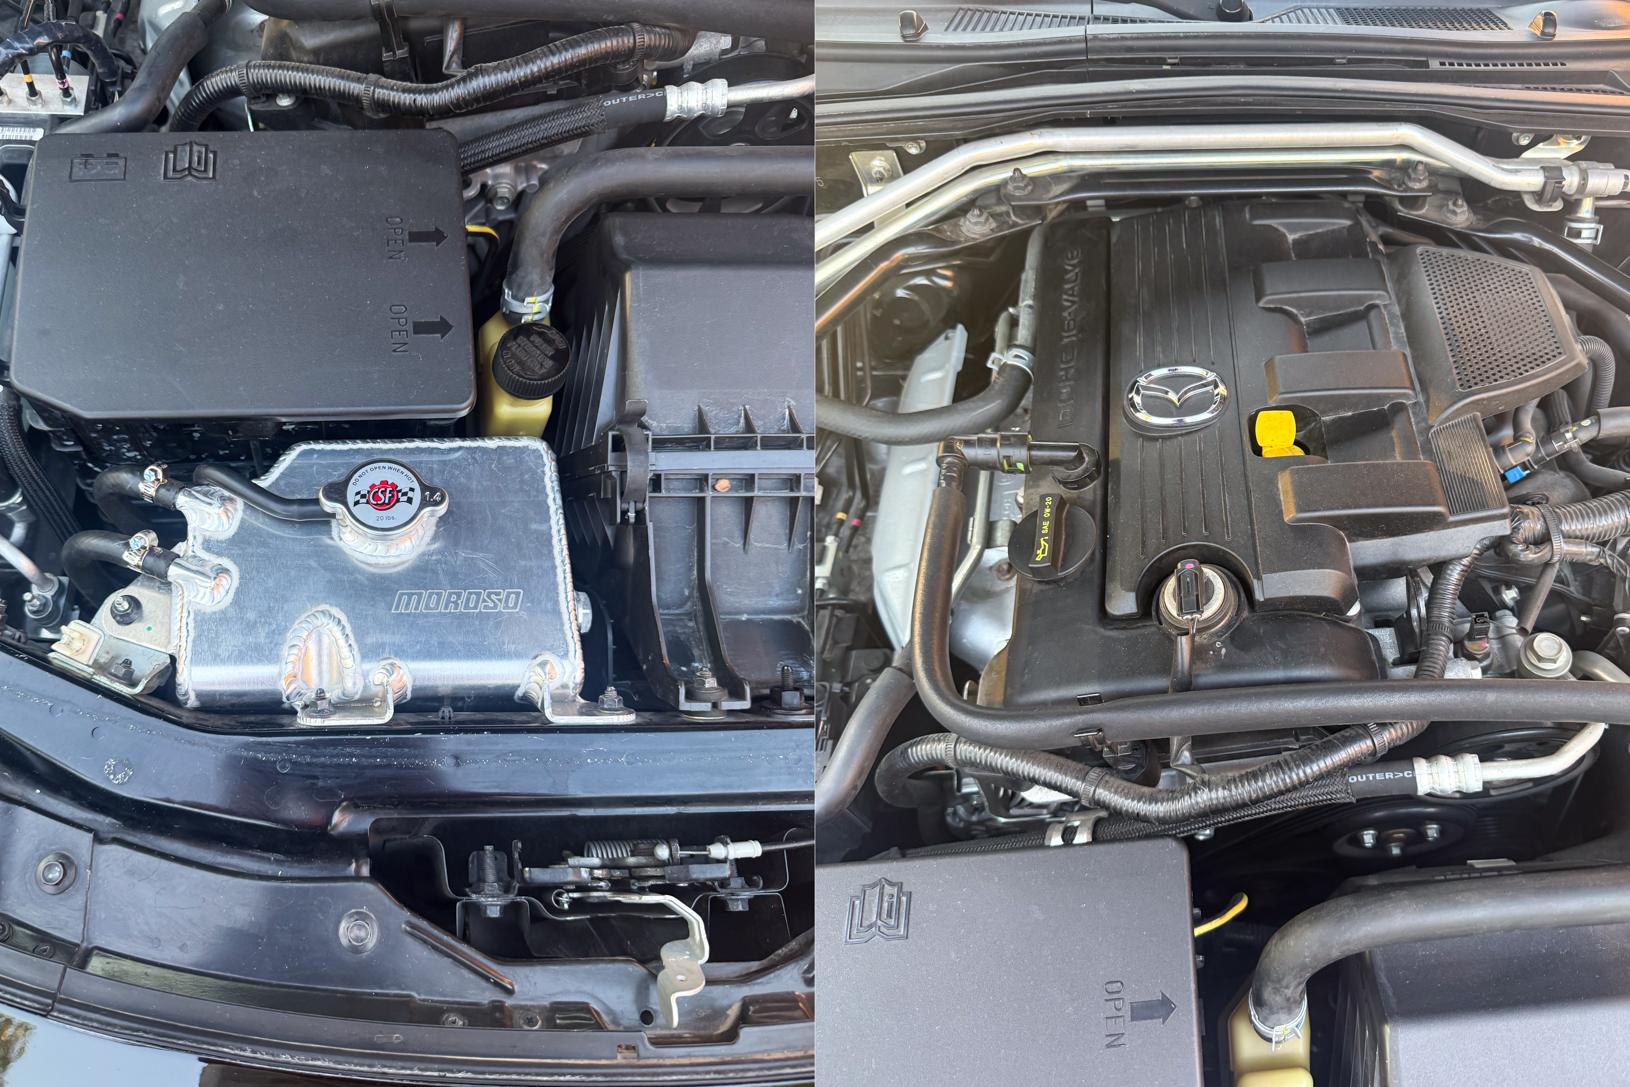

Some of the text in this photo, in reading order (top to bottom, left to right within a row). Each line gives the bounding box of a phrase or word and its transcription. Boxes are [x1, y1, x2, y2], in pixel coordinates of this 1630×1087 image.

[386, 216, 405, 260] OPEN
[389, 304, 408, 353] OPEN
[352, 477, 360, 486] DO
[358, 469, 369, 478] NOT
[387, 465, 404, 475] WHEN
[404, 474, 415, 484] HOT
[369, 487, 393, 505] CSF
[424, 491, 442, 503] 1.4
[1041, 496, 1052, 534] SAE 0W-20
[392, 589, 523, 613] MOROSO
[1348, 770, 1416, 783] OUTER>C
[1104, 980, 1126, 1049] OPEN
